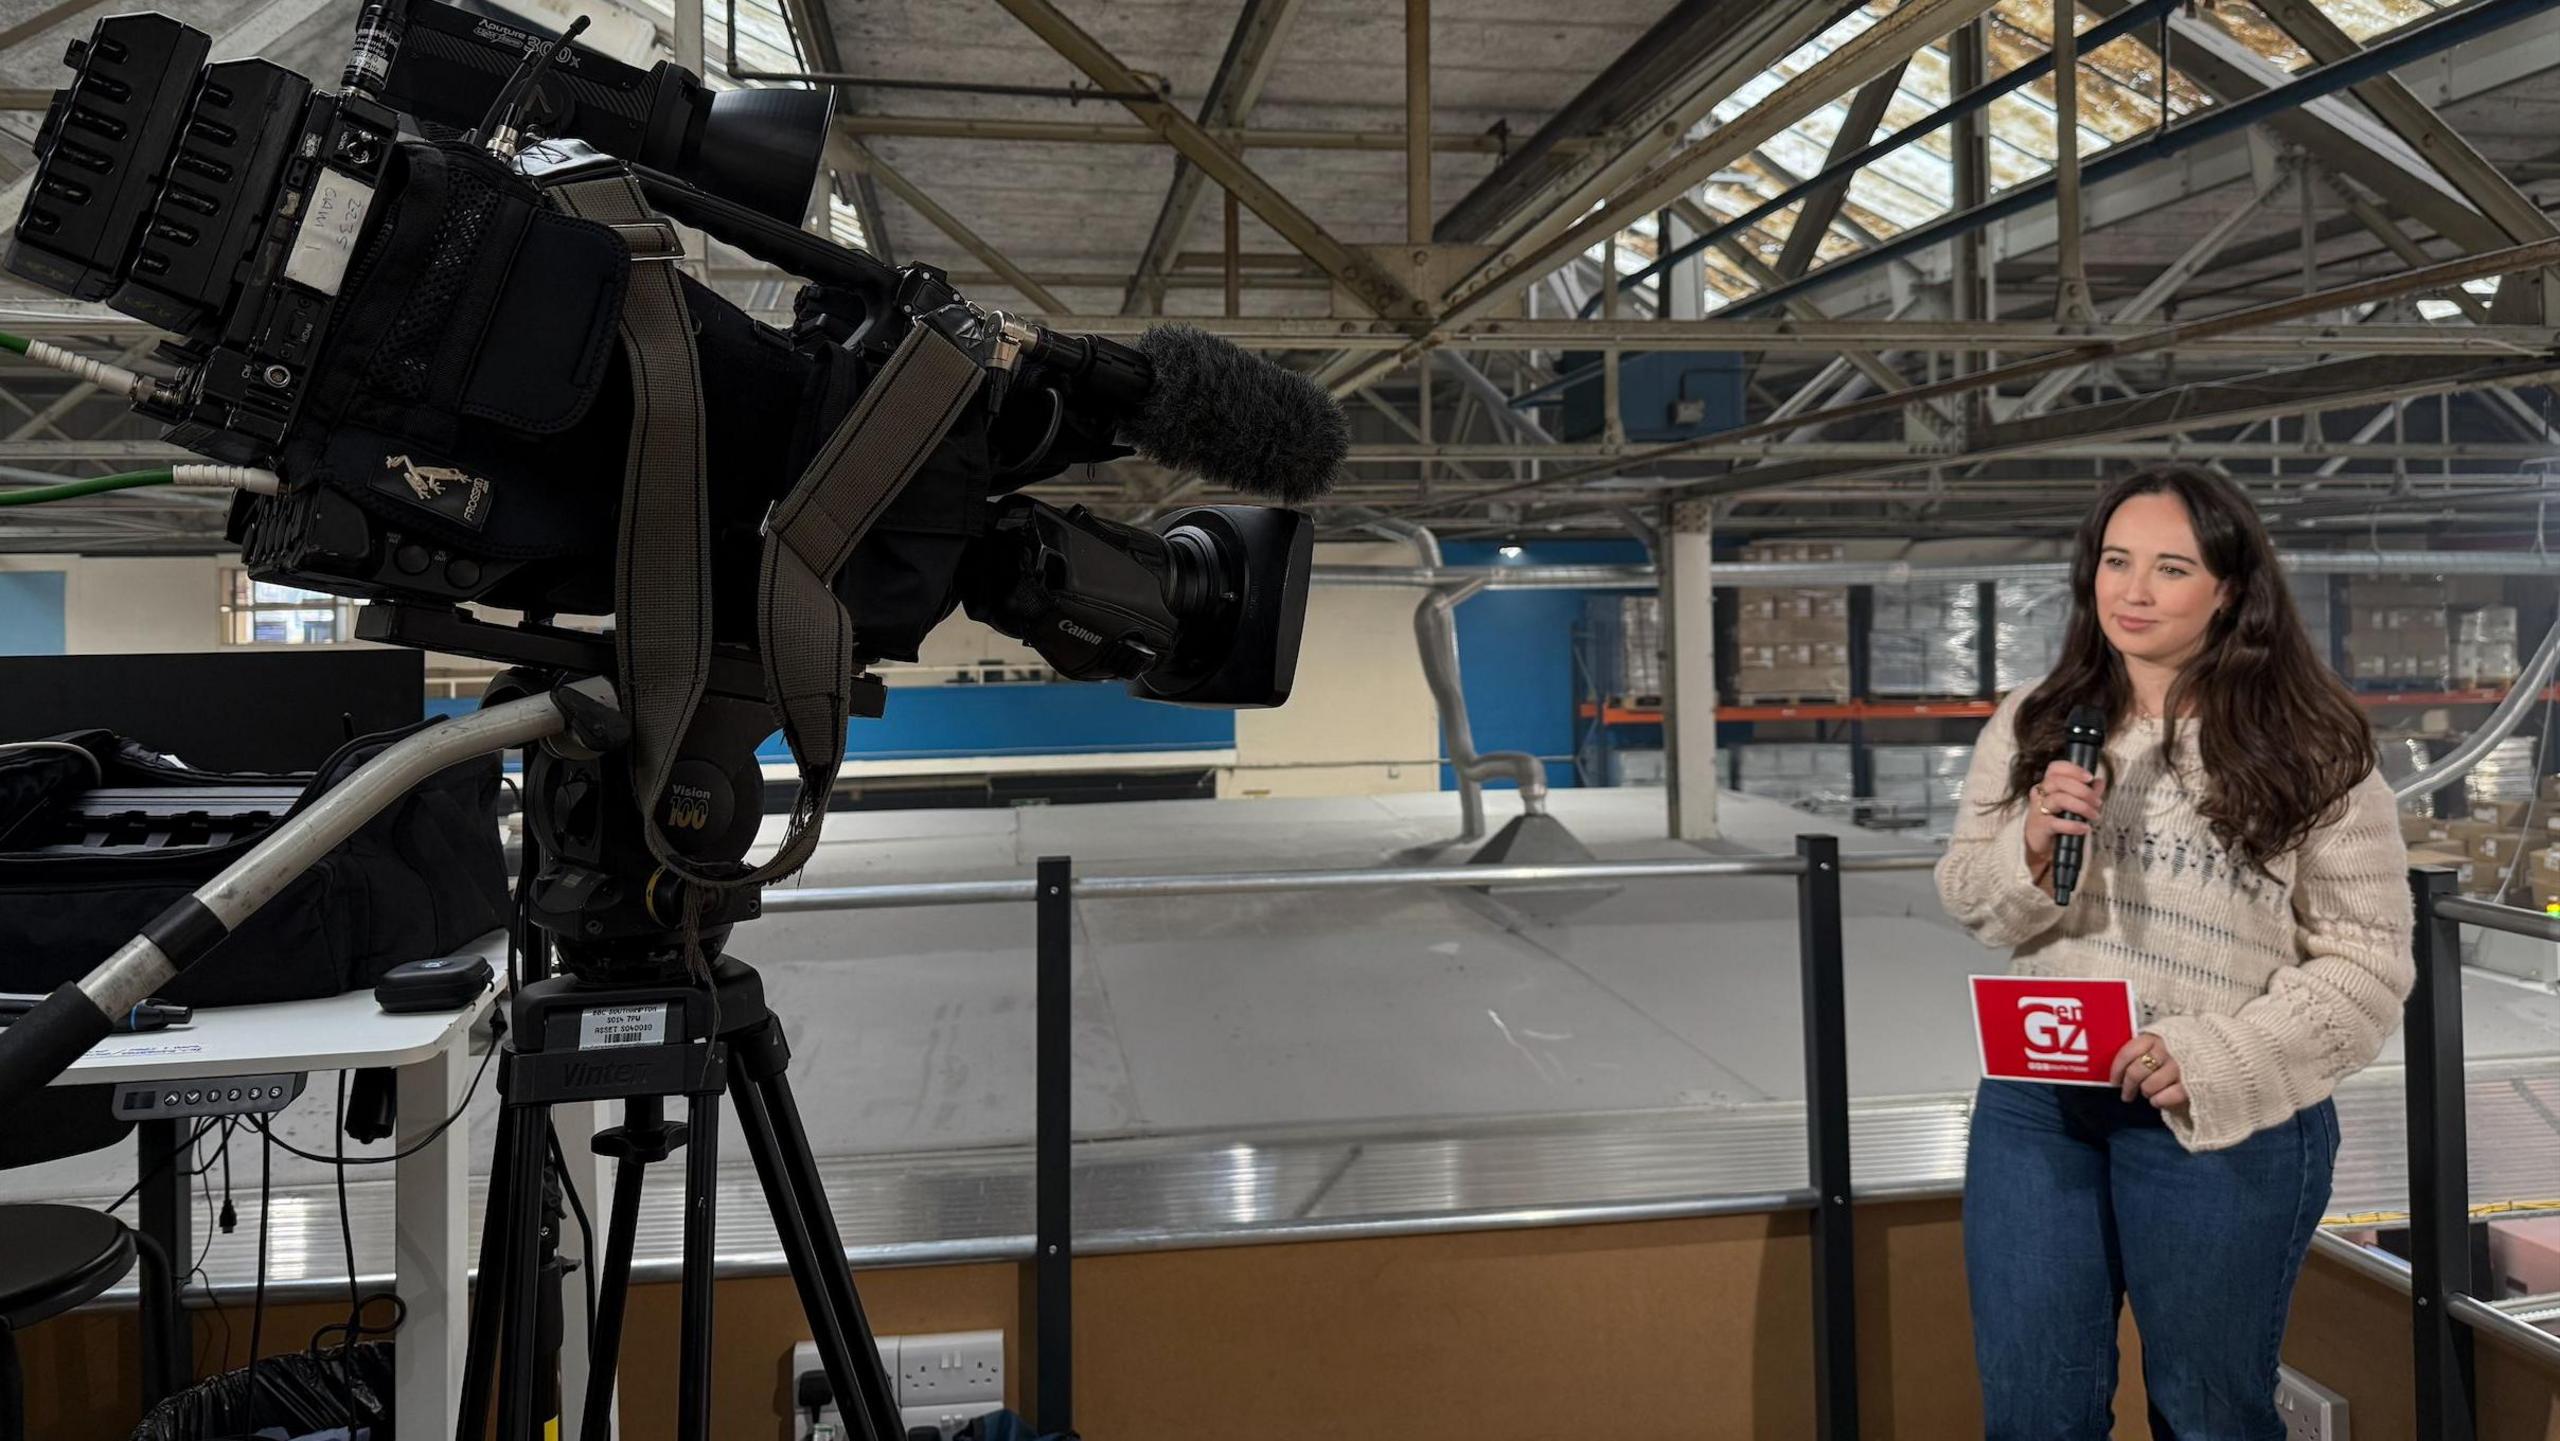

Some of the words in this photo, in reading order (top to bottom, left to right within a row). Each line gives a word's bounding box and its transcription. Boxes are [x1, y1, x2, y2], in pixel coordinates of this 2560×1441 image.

[1057, 619, 1103, 646] Canon
[672, 784, 712, 799] Vision
[668, 796, 710, 831] 100
[594, 1026, 618, 1034] ASSET
